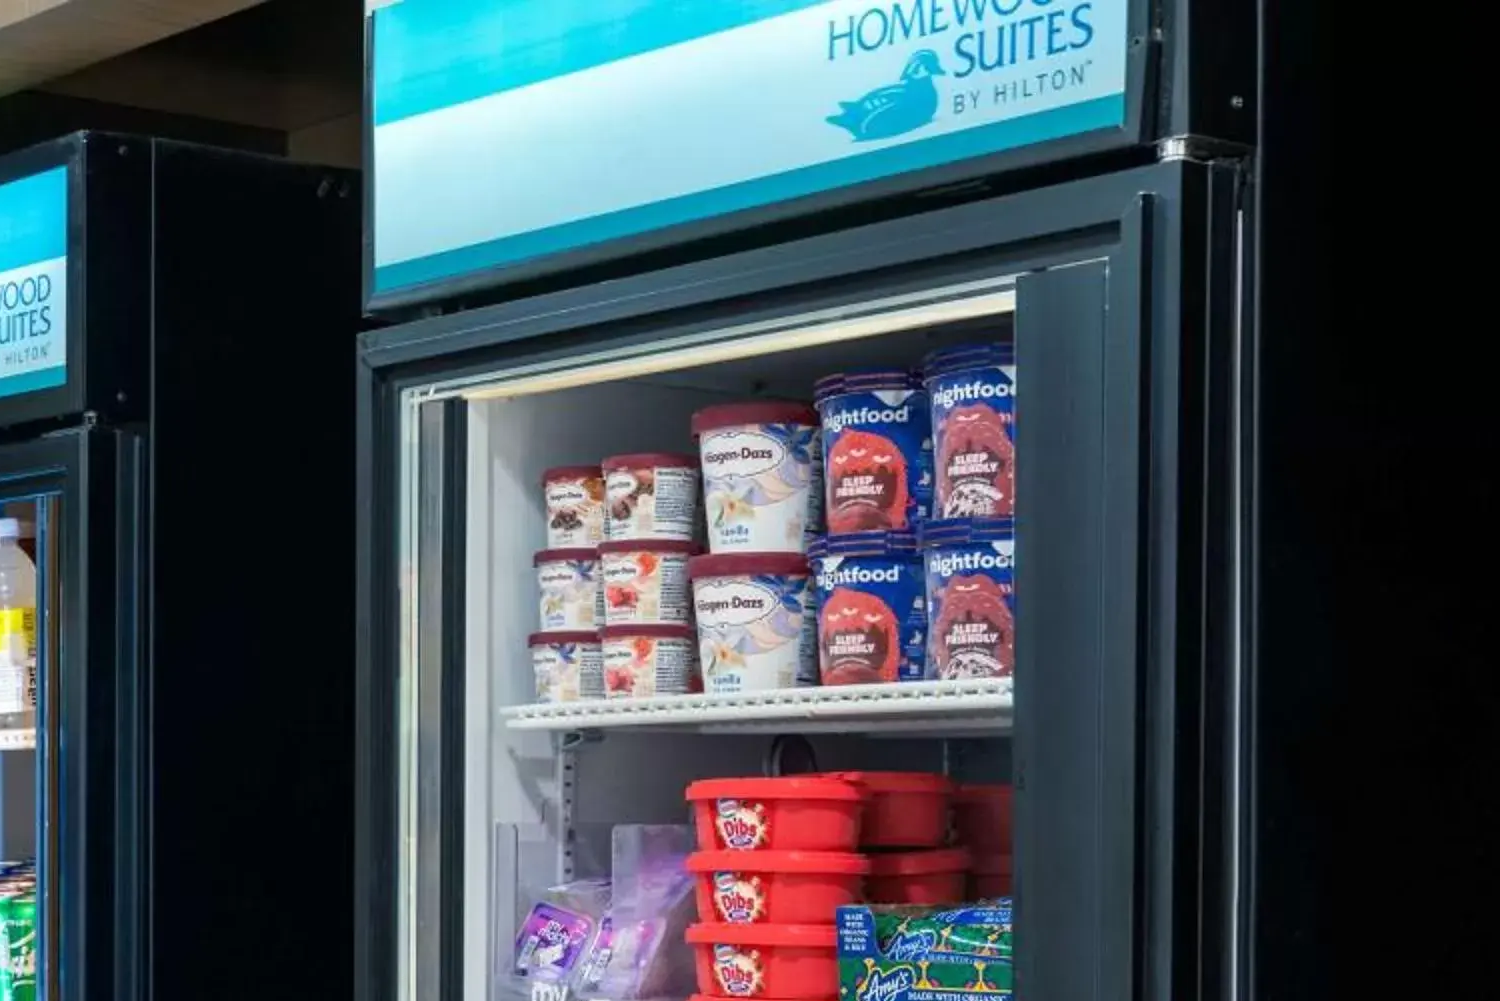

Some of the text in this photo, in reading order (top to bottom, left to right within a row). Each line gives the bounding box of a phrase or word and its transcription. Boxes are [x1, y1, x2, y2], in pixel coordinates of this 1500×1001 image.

[952, 2, 1095, 79] SUITES
[952, 89, 980, 115] BY
[723, 815, 757, 839] Dibs
[720, 890, 755, 912] Dibs
[721, 962, 754, 985] Dibs
